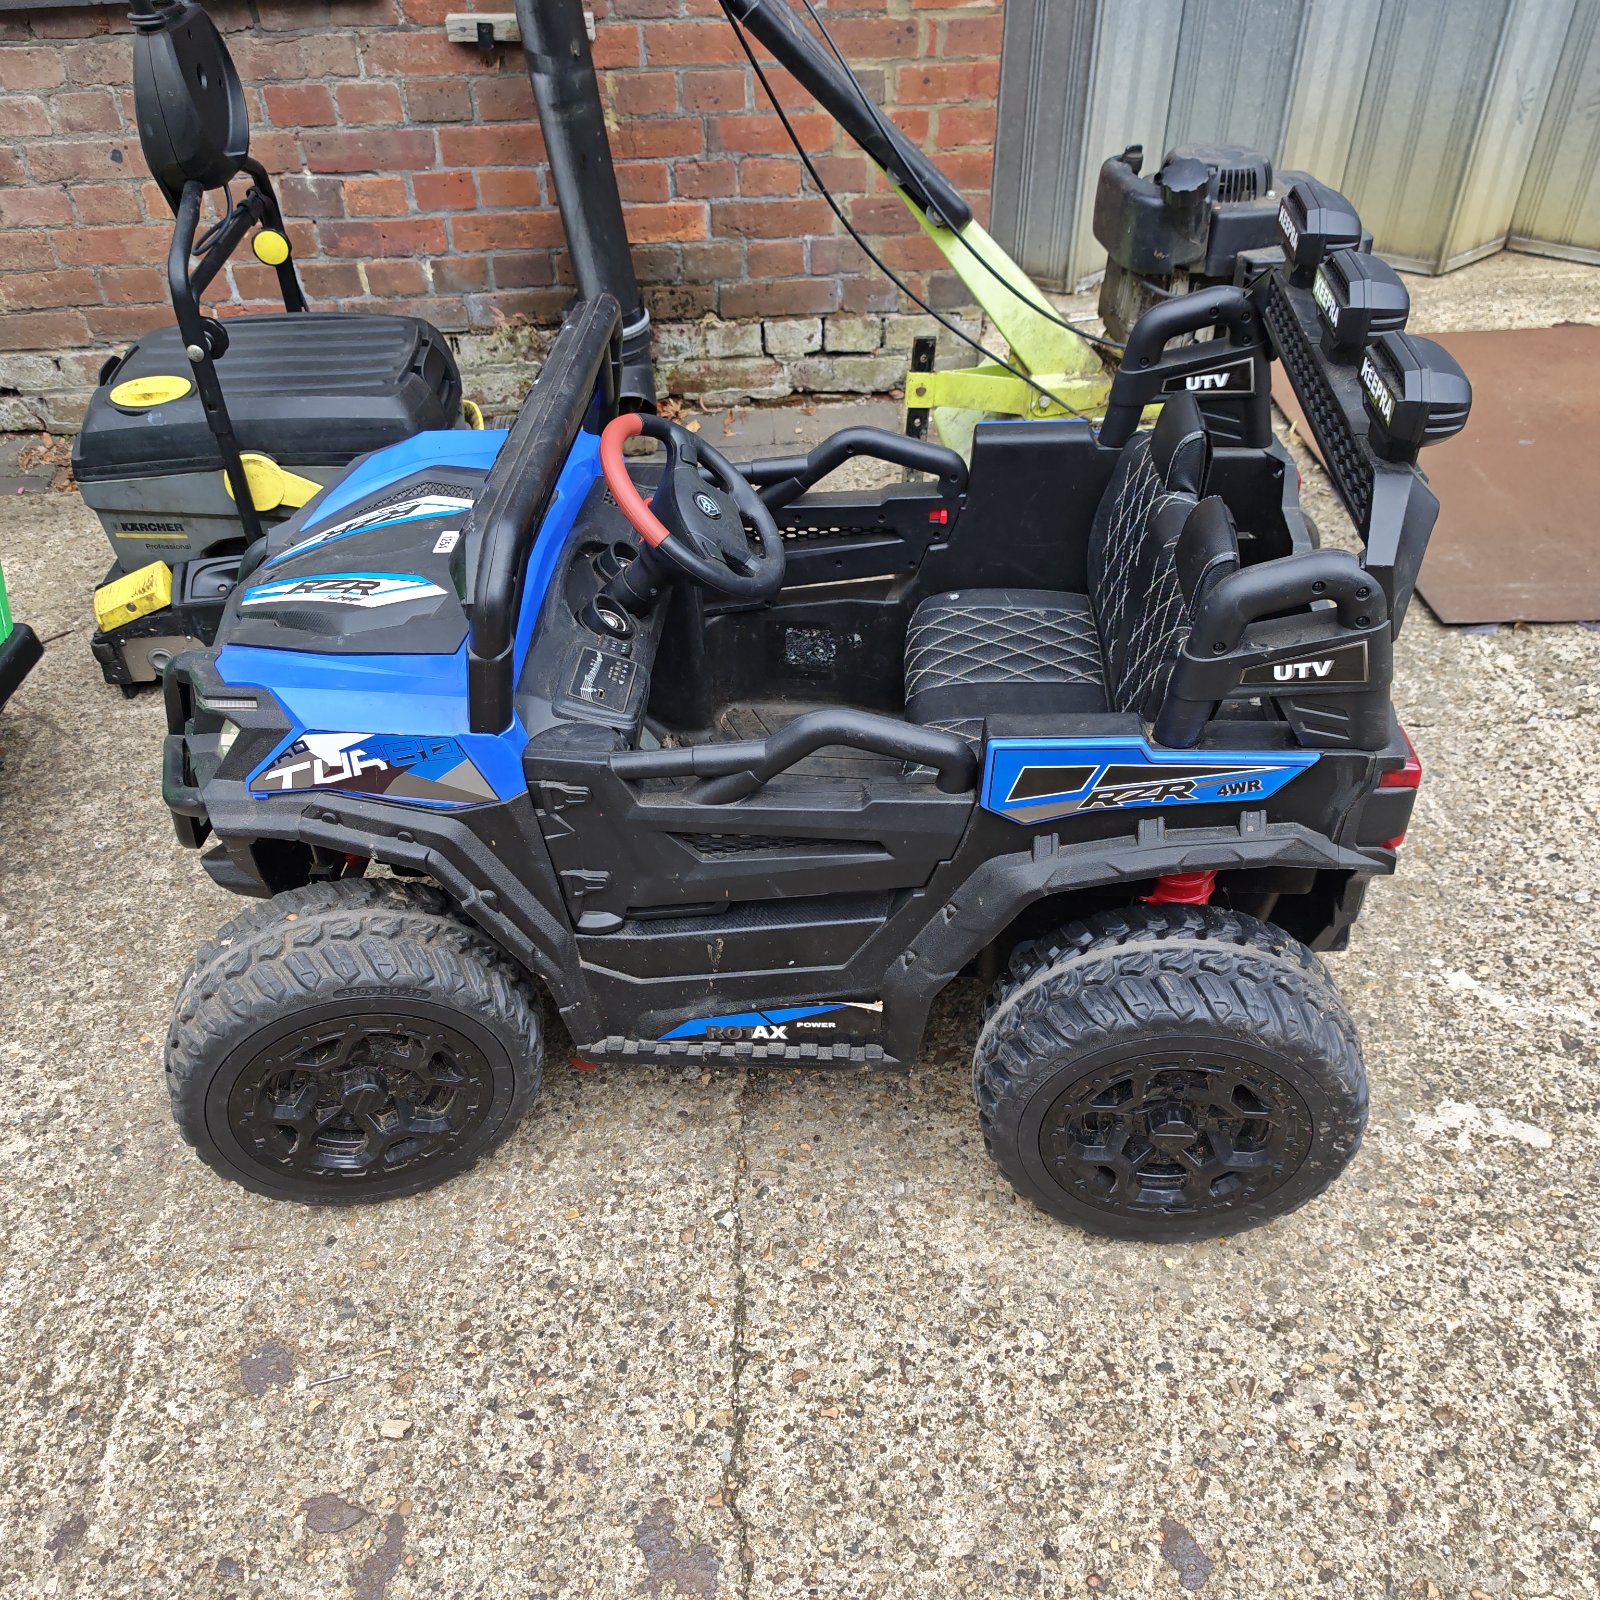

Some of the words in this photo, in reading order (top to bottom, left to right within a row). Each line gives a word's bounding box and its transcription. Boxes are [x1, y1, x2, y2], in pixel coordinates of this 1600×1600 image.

[1313, 277, 1341, 328] KEEPRA
[1185, 372, 1230, 391] UTV
[1361, 356, 1393, 422] KEEPRA
[285, 579, 381, 597] RZR
[1273, 659, 1335, 681] UTV
[1077, 780, 1199, 809] RZR
[1216, 779, 1262, 797] 4WR
[706, 1025, 789, 1041] ROTAX
[796, 1021, 837, 1029] POWER
